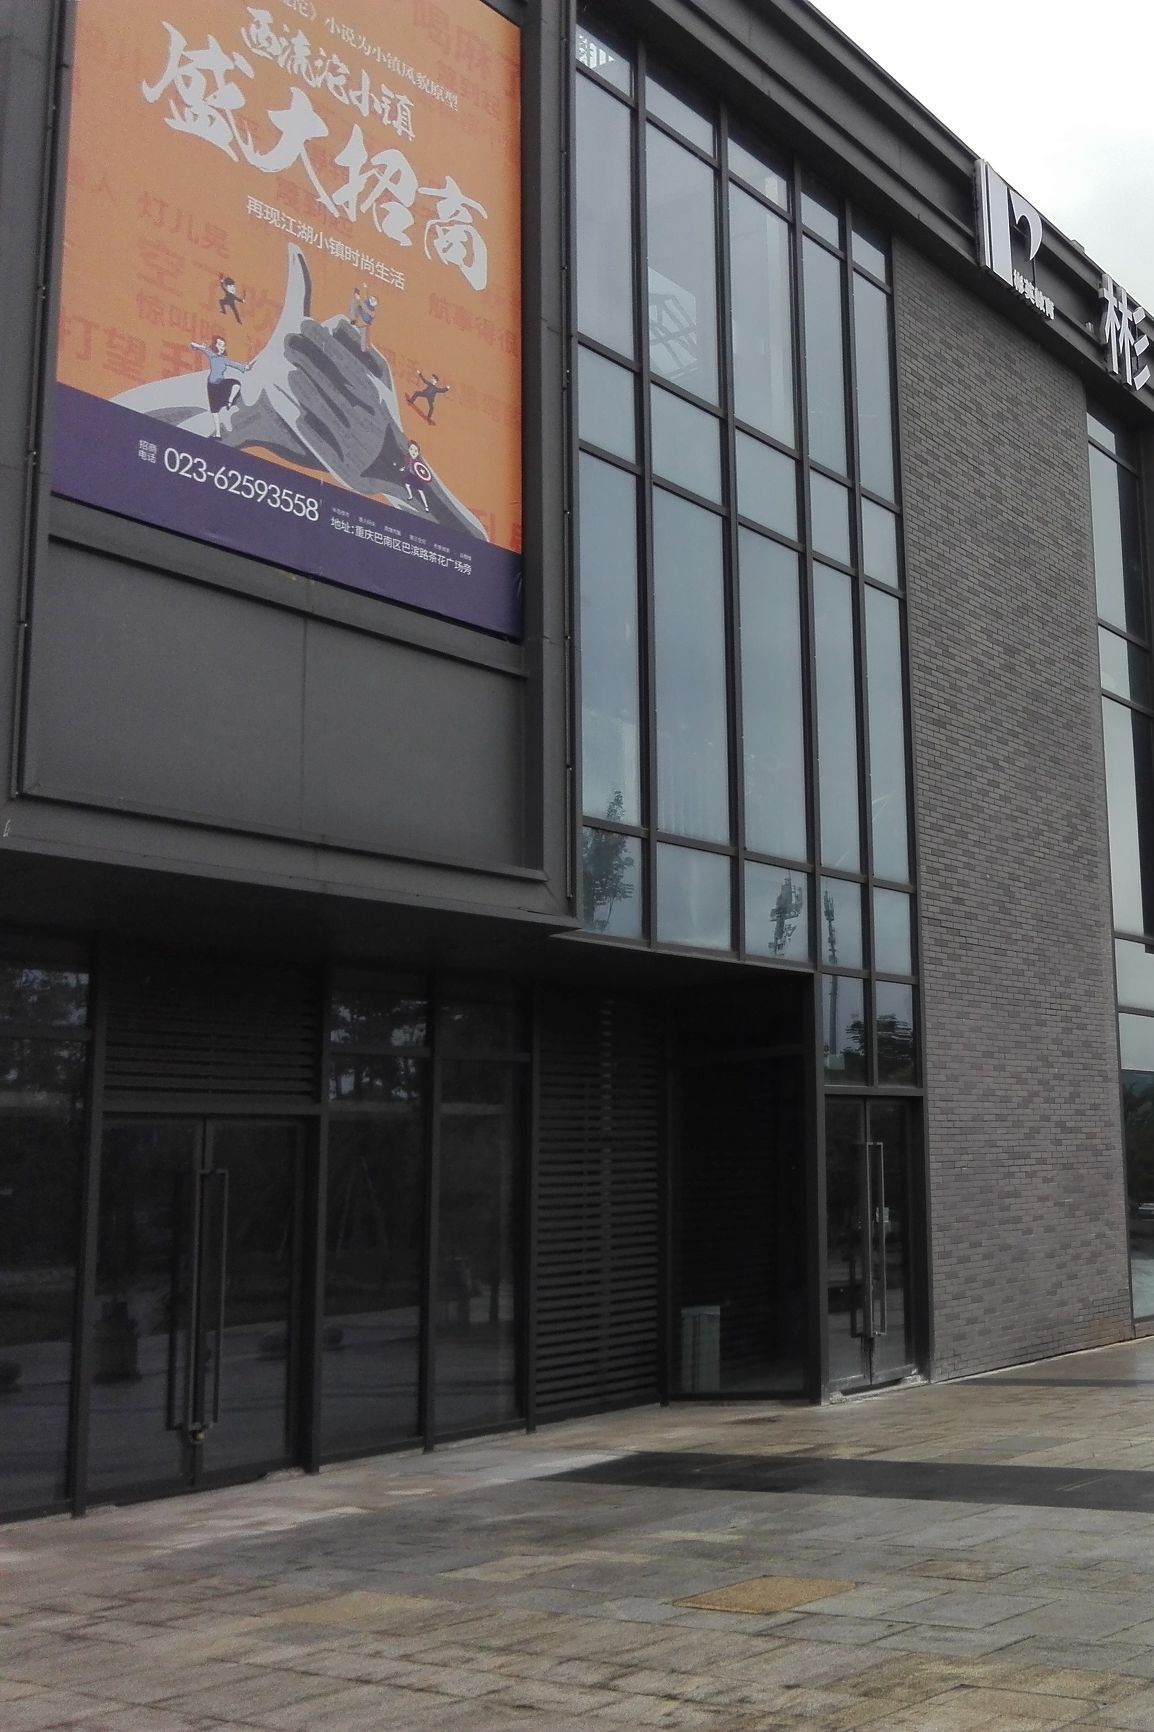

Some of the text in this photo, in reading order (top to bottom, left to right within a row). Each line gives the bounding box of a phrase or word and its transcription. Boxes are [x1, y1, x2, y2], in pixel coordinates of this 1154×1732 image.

[142, 20, 488, 290] 盛大招商
[246, 195, 406, 291] 再现江湖小镇时尚生活
[164, 447, 319, 521] 023-62593558
